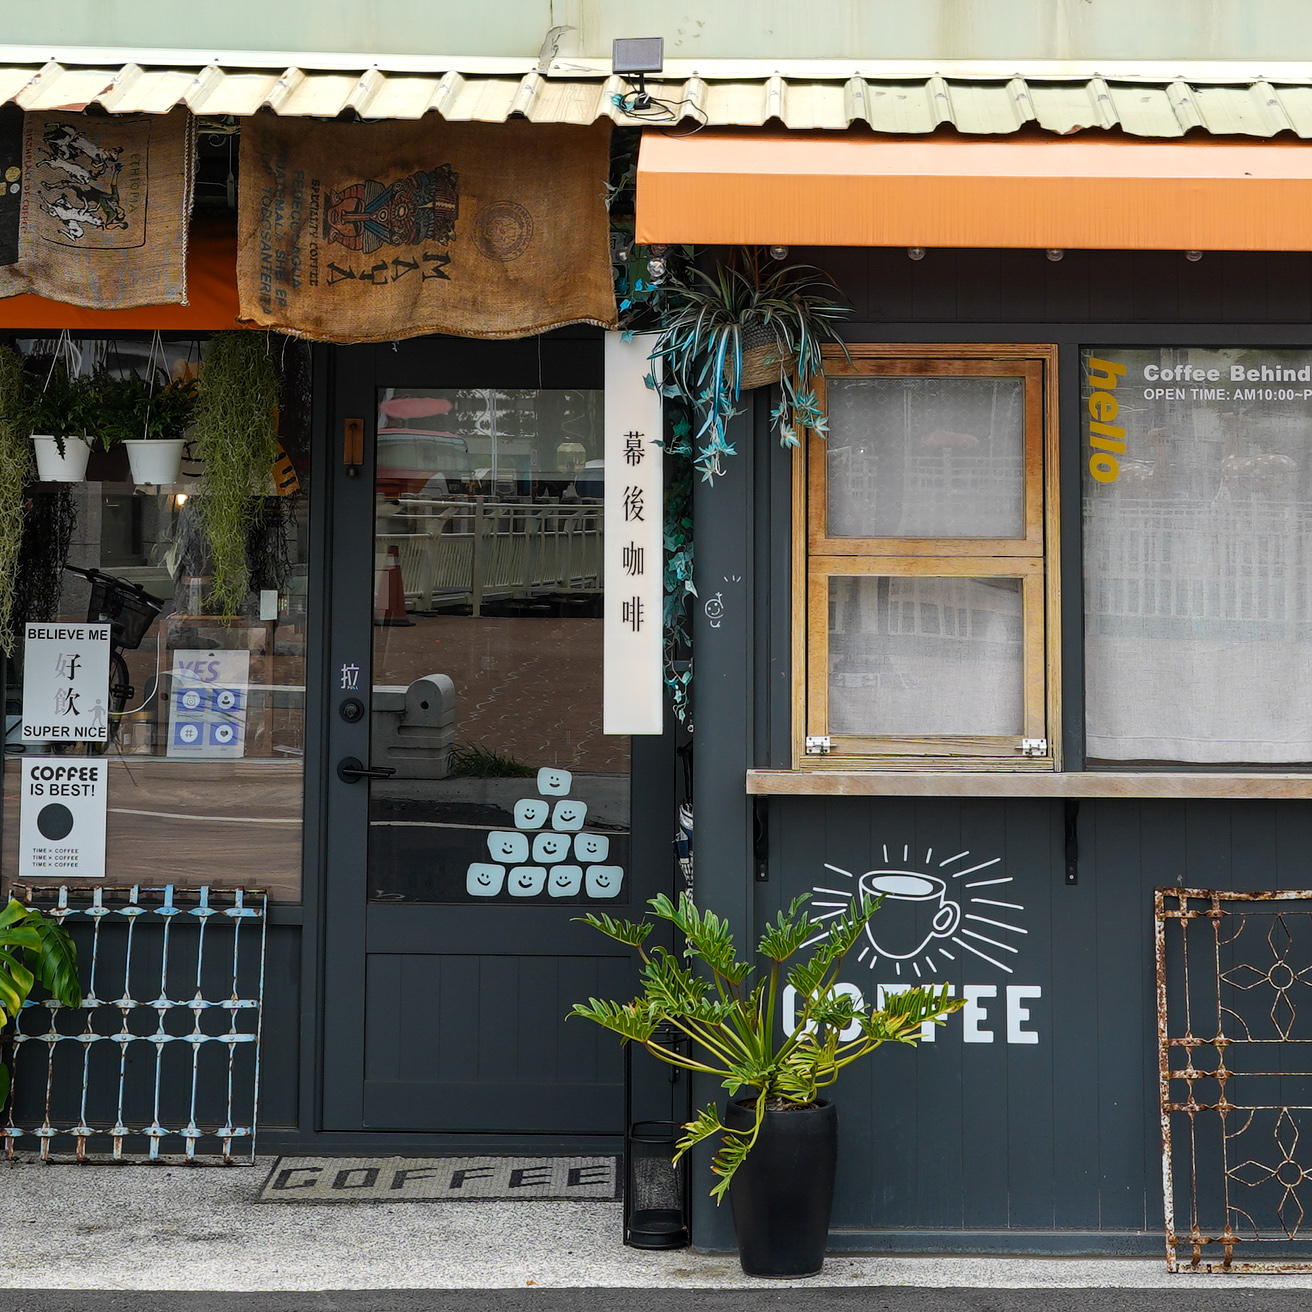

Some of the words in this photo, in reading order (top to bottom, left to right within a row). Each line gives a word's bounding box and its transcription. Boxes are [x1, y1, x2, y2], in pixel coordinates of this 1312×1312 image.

[309, 240, 319, 287] COFFEE
[1143, 364, 1220, 382] Coffee
[1230, 365, 1311, 382] Behind
[1143, 388, 1186, 401] OPEN
[1190, 388, 1230, 401] TIME:
[1089, 357, 1126, 483] hello
[622, 431, 646, 633] 幕後咖啡
[28, 628, 84, 640] BELIEVE
[88, 629, 108, 640] ME
[178, 661, 221, 682] YES
[341, 663, 360, 689] 拉
[23, 725, 70, 737] SUPER
[74, 726, 107, 738] NICE
[31, 766, 98, 781] COFFEE
[31, 784, 44, 796] IS
[50, 784, 95, 797] BEST!
[271, 1165, 610, 1189] COFFEE
